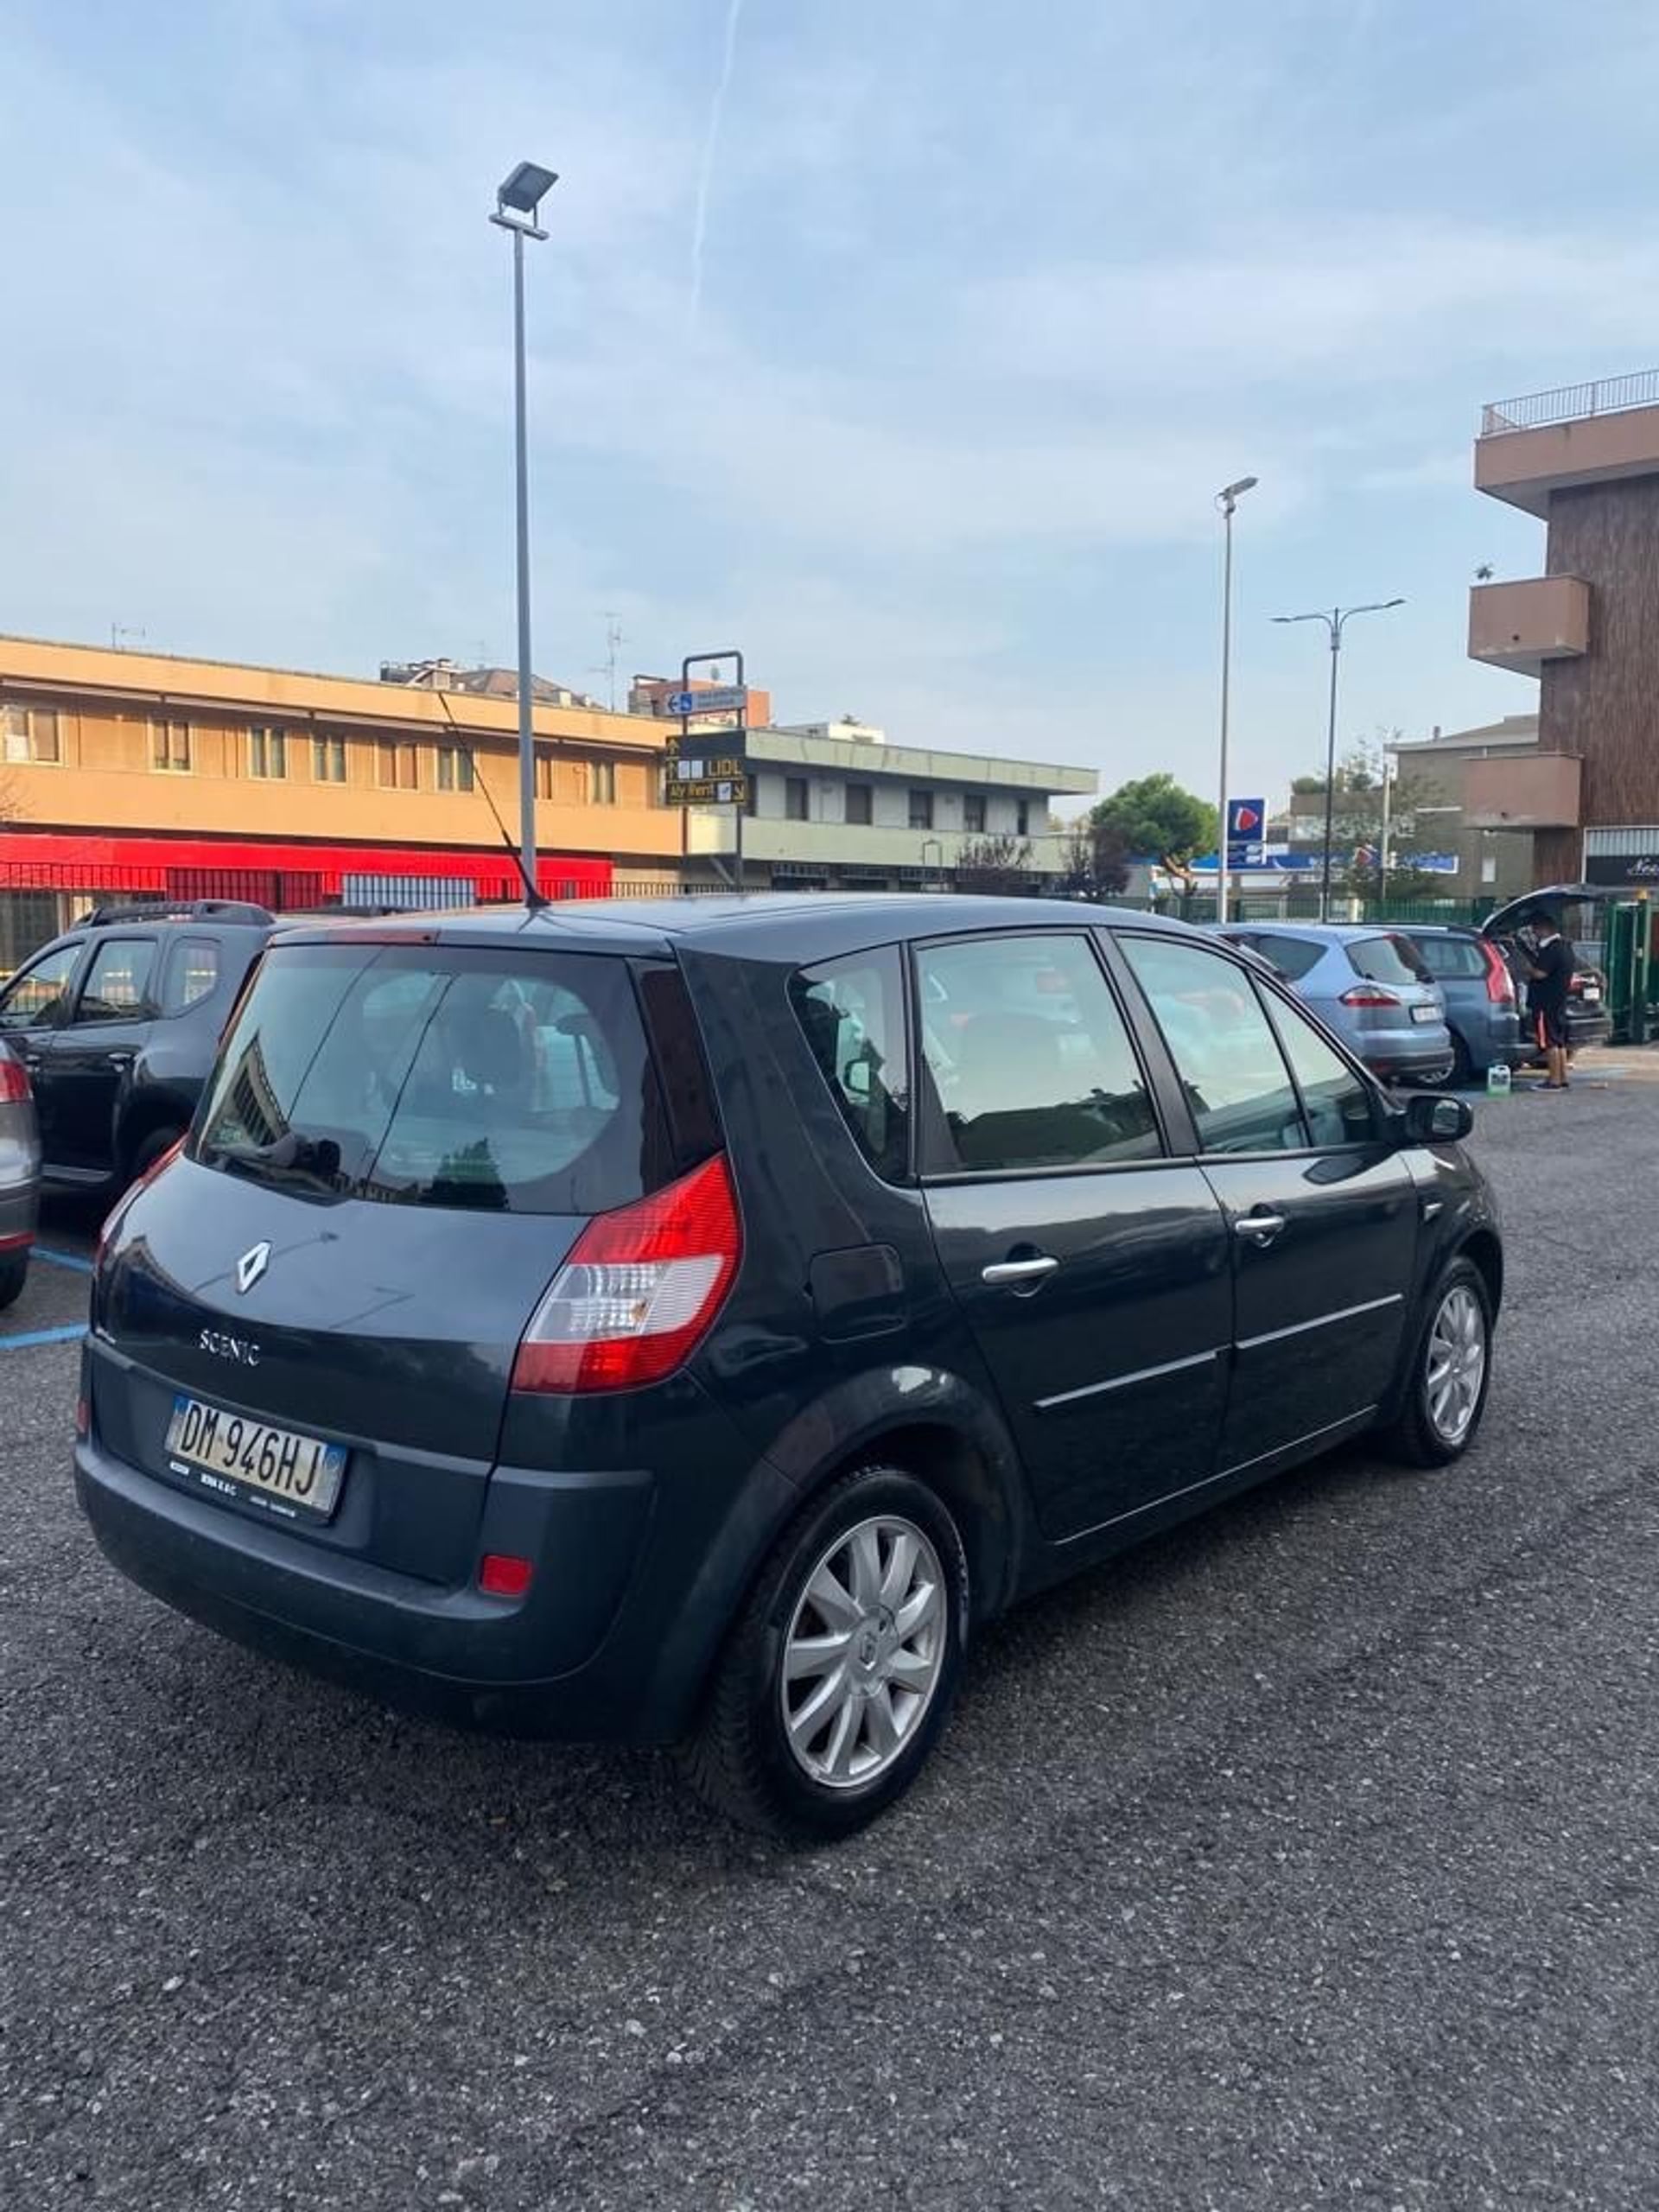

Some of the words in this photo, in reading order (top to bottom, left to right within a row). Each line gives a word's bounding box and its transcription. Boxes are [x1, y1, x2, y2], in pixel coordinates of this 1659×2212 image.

[708, 760, 743, 777] LIDL
[200, 1329, 261, 1367] SCENIC
[180, 1403, 220, 1460] DM
[222, 1419, 321, 1497] 946HJ
